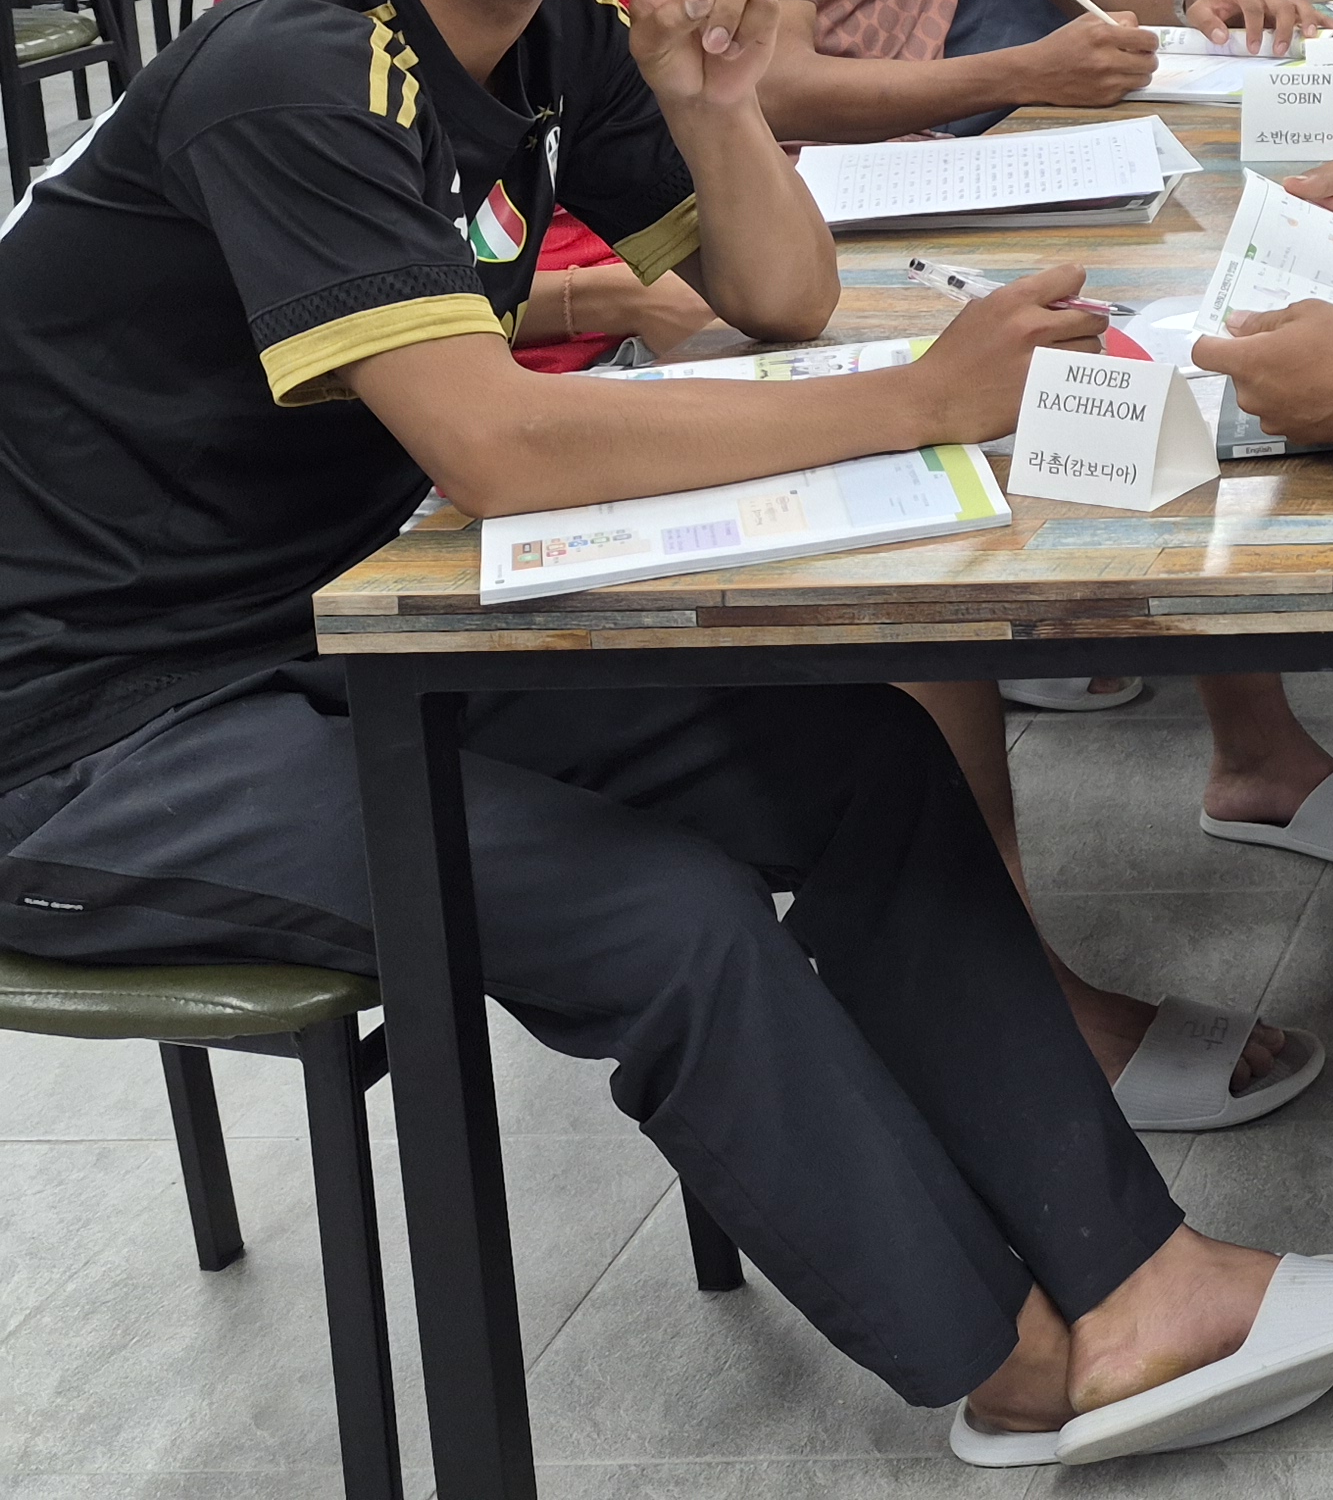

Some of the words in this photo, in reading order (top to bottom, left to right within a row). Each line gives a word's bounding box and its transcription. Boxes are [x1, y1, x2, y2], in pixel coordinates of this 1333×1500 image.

[1269, 73, 1333, 86] VOEURN
[1277, 92, 1323, 105] SOBIN
[1065, 365, 1131, 389] NHOEB
[1037, 391, 1147, 422] RACHHAOM
[1245, 445, 1273, 455] English
[1029, 450, 1138, 485] 라촘(캄보디아)
